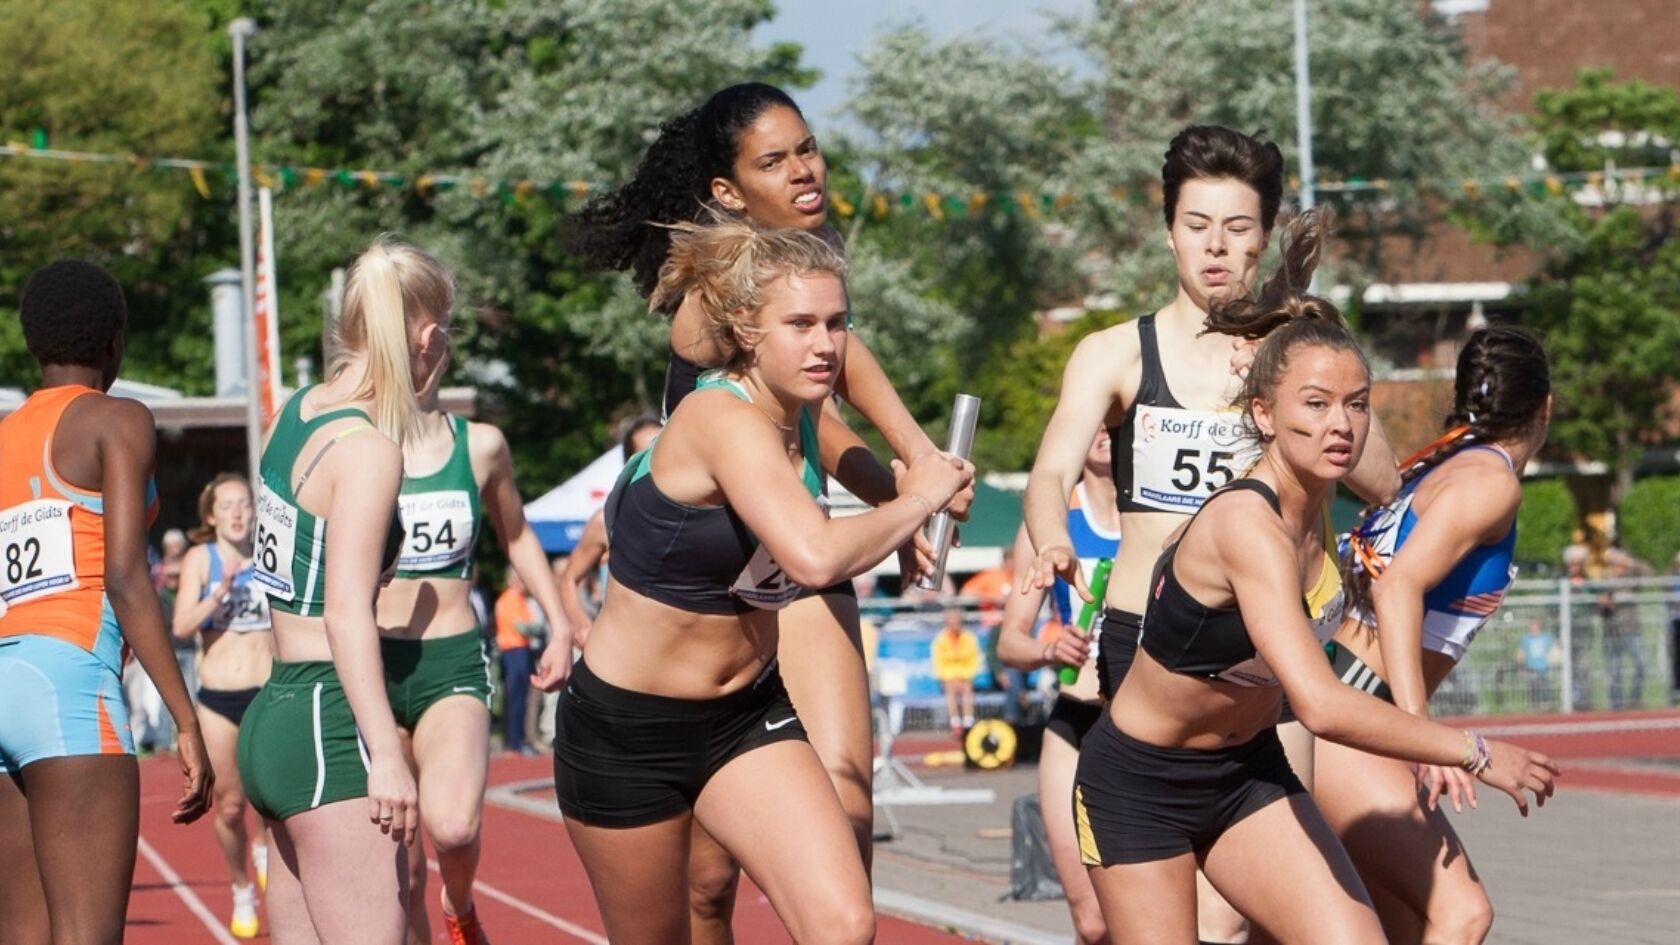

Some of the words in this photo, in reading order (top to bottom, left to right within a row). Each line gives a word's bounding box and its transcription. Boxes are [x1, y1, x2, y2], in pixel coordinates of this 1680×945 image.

[1160, 419, 1203, 439] Korff
[1208, 423, 1227, 436] de
[1171, 448, 1235, 493] 55
[21, 511, 33, 526] de
[35, 505, 63, 522] Gidts
[257, 523, 278, 573] 56
[412, 519, 457, 553] 54
[6, 536, 43, 584] 82
[755, 558, 792, 590] 2
